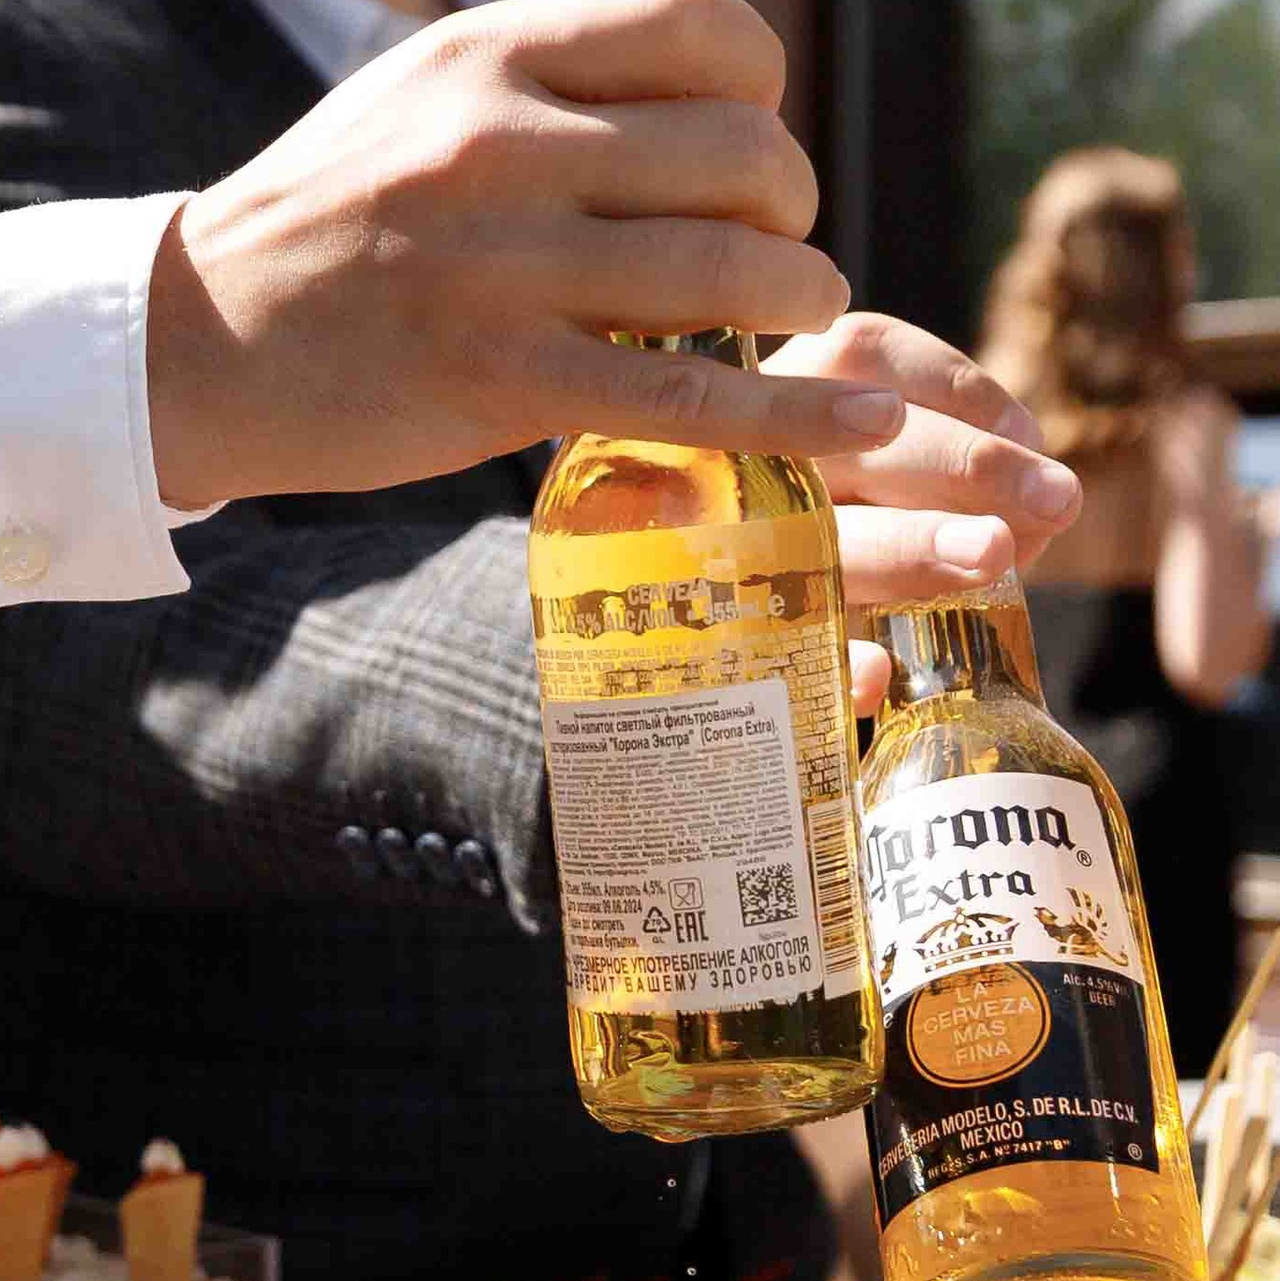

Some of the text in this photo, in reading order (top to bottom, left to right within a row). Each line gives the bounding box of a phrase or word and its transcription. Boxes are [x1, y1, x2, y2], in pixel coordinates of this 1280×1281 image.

[616, 715, 662, 733] светлый
[664, 701, 756, 731] фильтрованный
[893, 868, 1037, 924] Extra
[631, 948, 736, 974] УПОТРЕБЛЕНИЕ
[740, 935, 810, 965] АЛКОГОЛЯ
[573, 954, 811, 995] ВРЕДИТ ВАШЕМУ ЗДОРОВЬЮ
[956, 981, 989, 1004] LA
[923, 995, 1036, 1035] CERVEZA
[953, 1019, 1007, 1047] MAS
[955, 1039, 1013, 1067] FINA
[1033, 1097, 1055, 1116] DE
[1091, 1098, 1113, 1119] DE
[960, 1120, 1024, 1151] MEXICO
